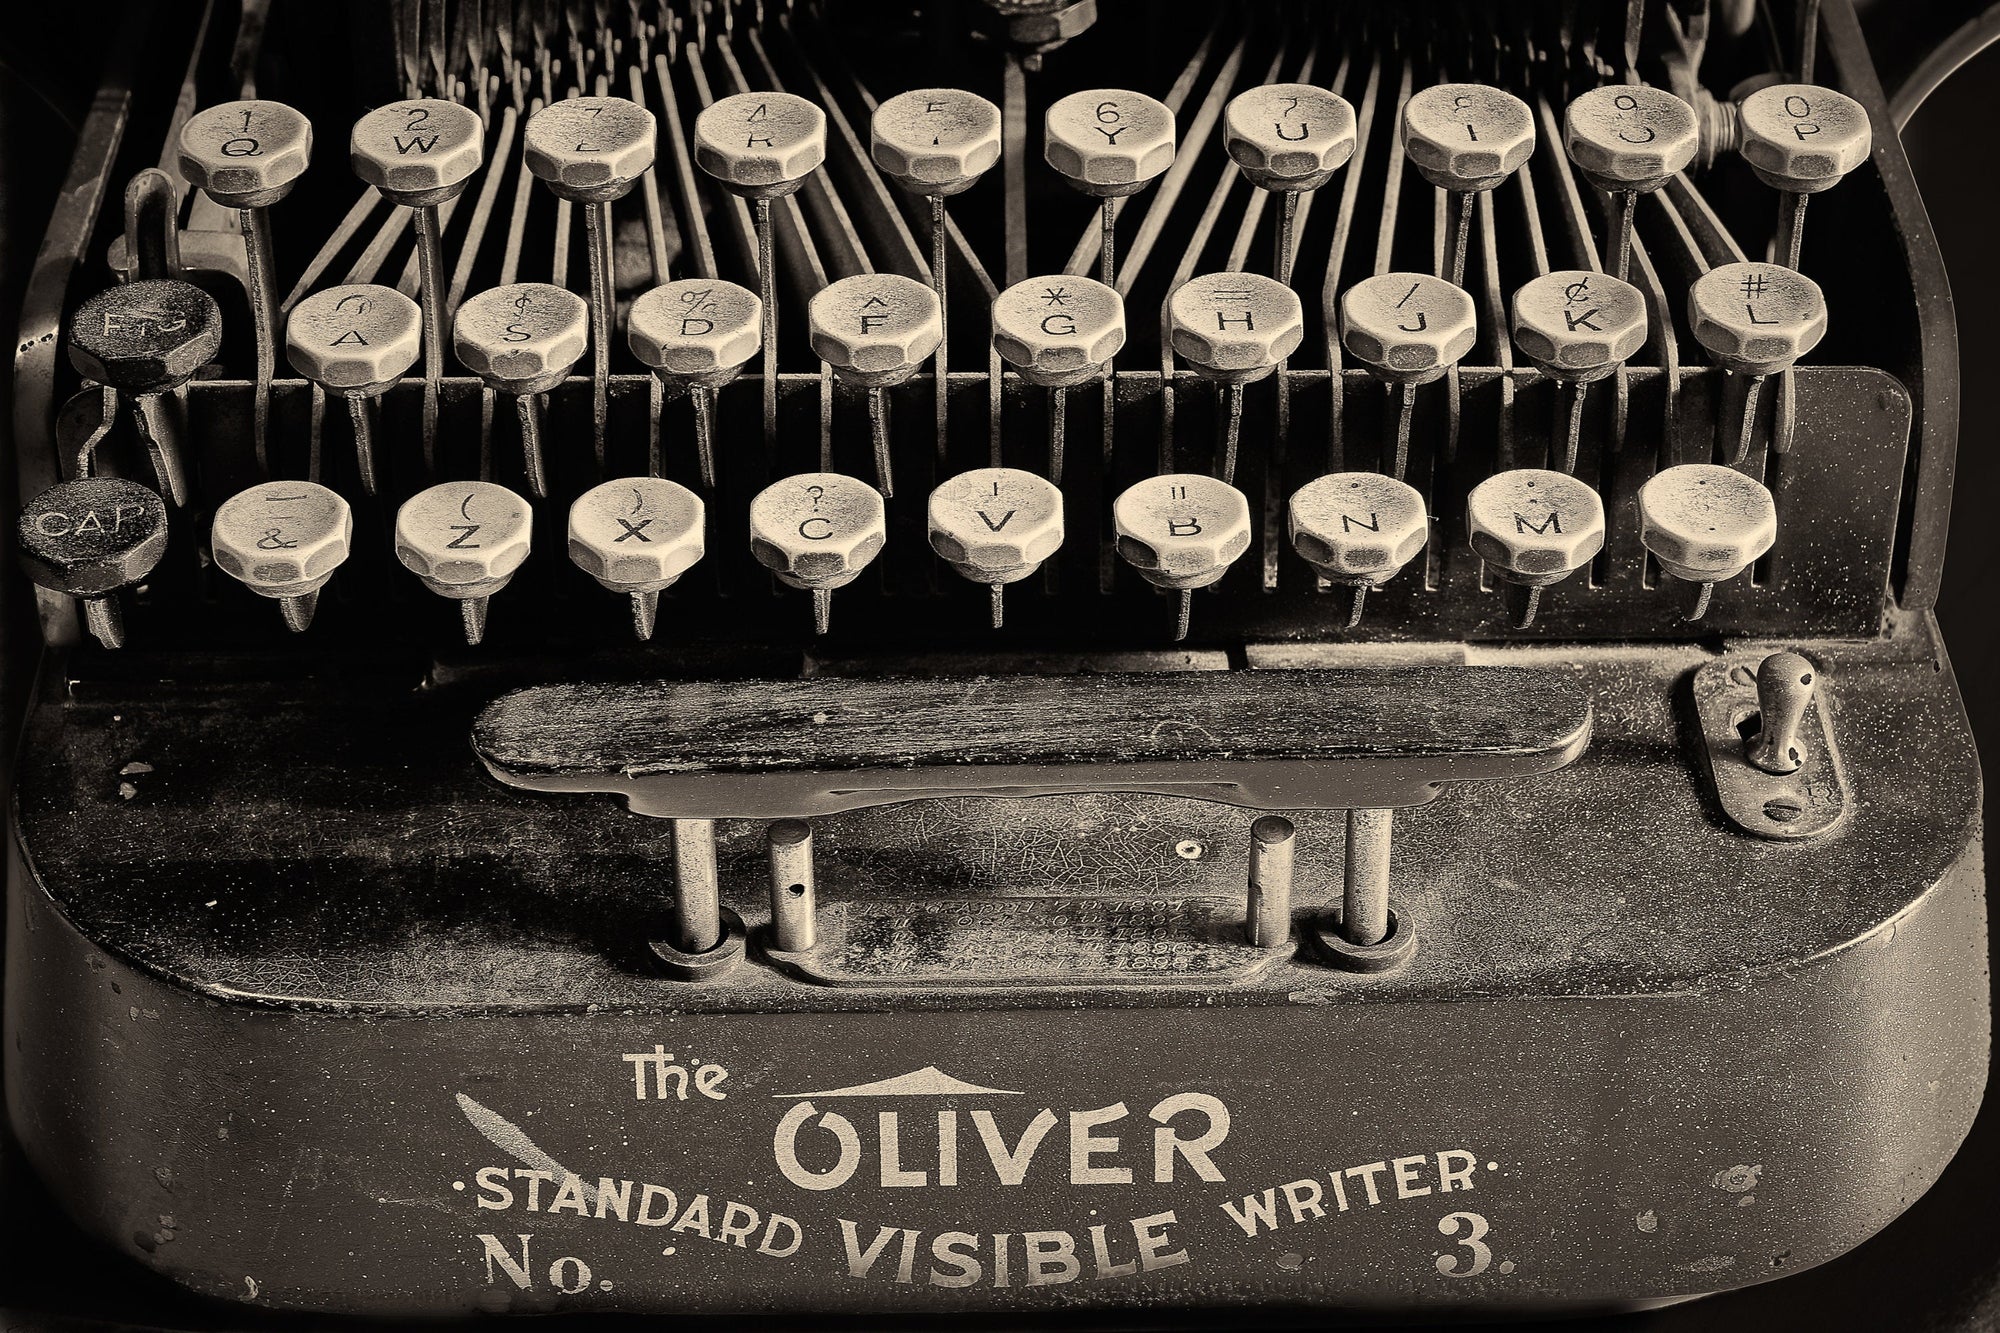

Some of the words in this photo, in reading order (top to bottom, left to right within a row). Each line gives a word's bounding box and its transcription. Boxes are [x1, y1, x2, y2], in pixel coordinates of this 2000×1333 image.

[404, 108, 429, 132] 2
[1096, 101, 1120, 124] 6
[1092, 126, 1129, 145] Y
[1274, 122, 1309, 142] U
[1794, 123, 1821, 141] P
[221, 138, 263, 157] Q
[393, 134, 440, 155] W
[860, 315, 888, 335] F
[1040, 314, 1077, 336] G
[1216, 312, 1254, 331] H
[1397, 312, 1427, 332] J
[1563, 308, 1604, 332] K
[1746, 304, 1779, 324] L
[329, 329, 370, 347] A
[502, 323, 532, 342] S
[680, 318, 714, 336] D
[806, 485, 824, 512] ?
[35, 504, 145, 537] CAP
[612, 518, 654, 542] X
[798, 517, 833, 540] C
[975, 509, 1017, 532] V
[1167, 517, 1202, 537] B
[1342, 512, 1380, 533] N
[1513, 511, 1562, 534] M
[256, 528, 299, 550] &
[446, 525, 481, 549] Z
[622, 1044, 729, 1101] The
[773, 1092, 1231, 1191] OLIVER
[474, 1166, 803, 1258] STANDARD
[837, 1210, 1190, 1288] VISIBLE
[1219, 1149, 1478, 1238] WRITER
[475, 1233, 613, 1295] No.
[1435, 1211, 1515, 1279] 3.
